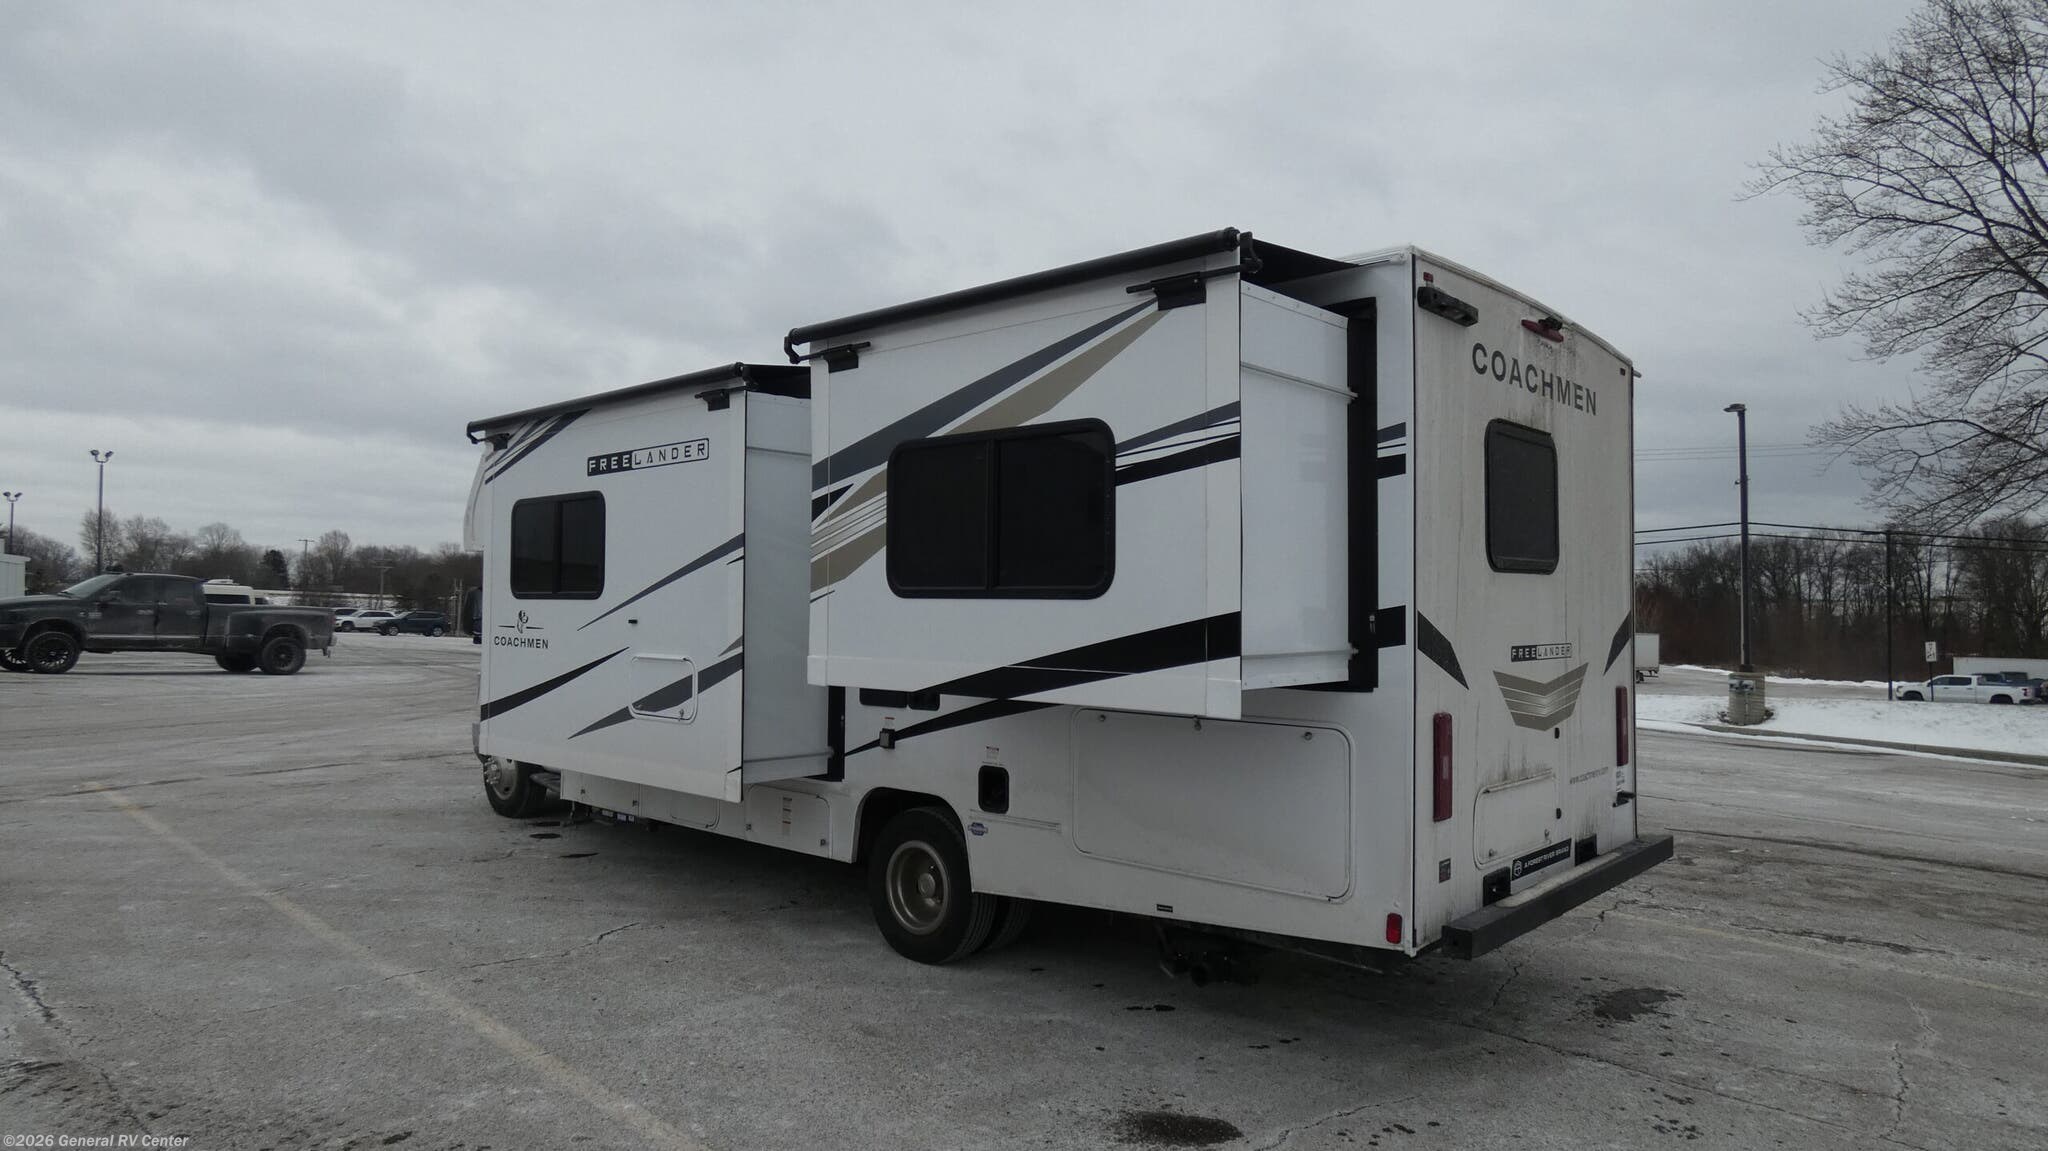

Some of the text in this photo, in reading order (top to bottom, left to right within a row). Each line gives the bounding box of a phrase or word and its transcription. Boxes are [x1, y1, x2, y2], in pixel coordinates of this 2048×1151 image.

[1472, 342, 1597, 416] COACHMEN
[588, 442, 705, 473] FREELANDER
[493, 635, 549, 649] COACHMEN
[1511, 645, 1571, 659] FREELANDER
